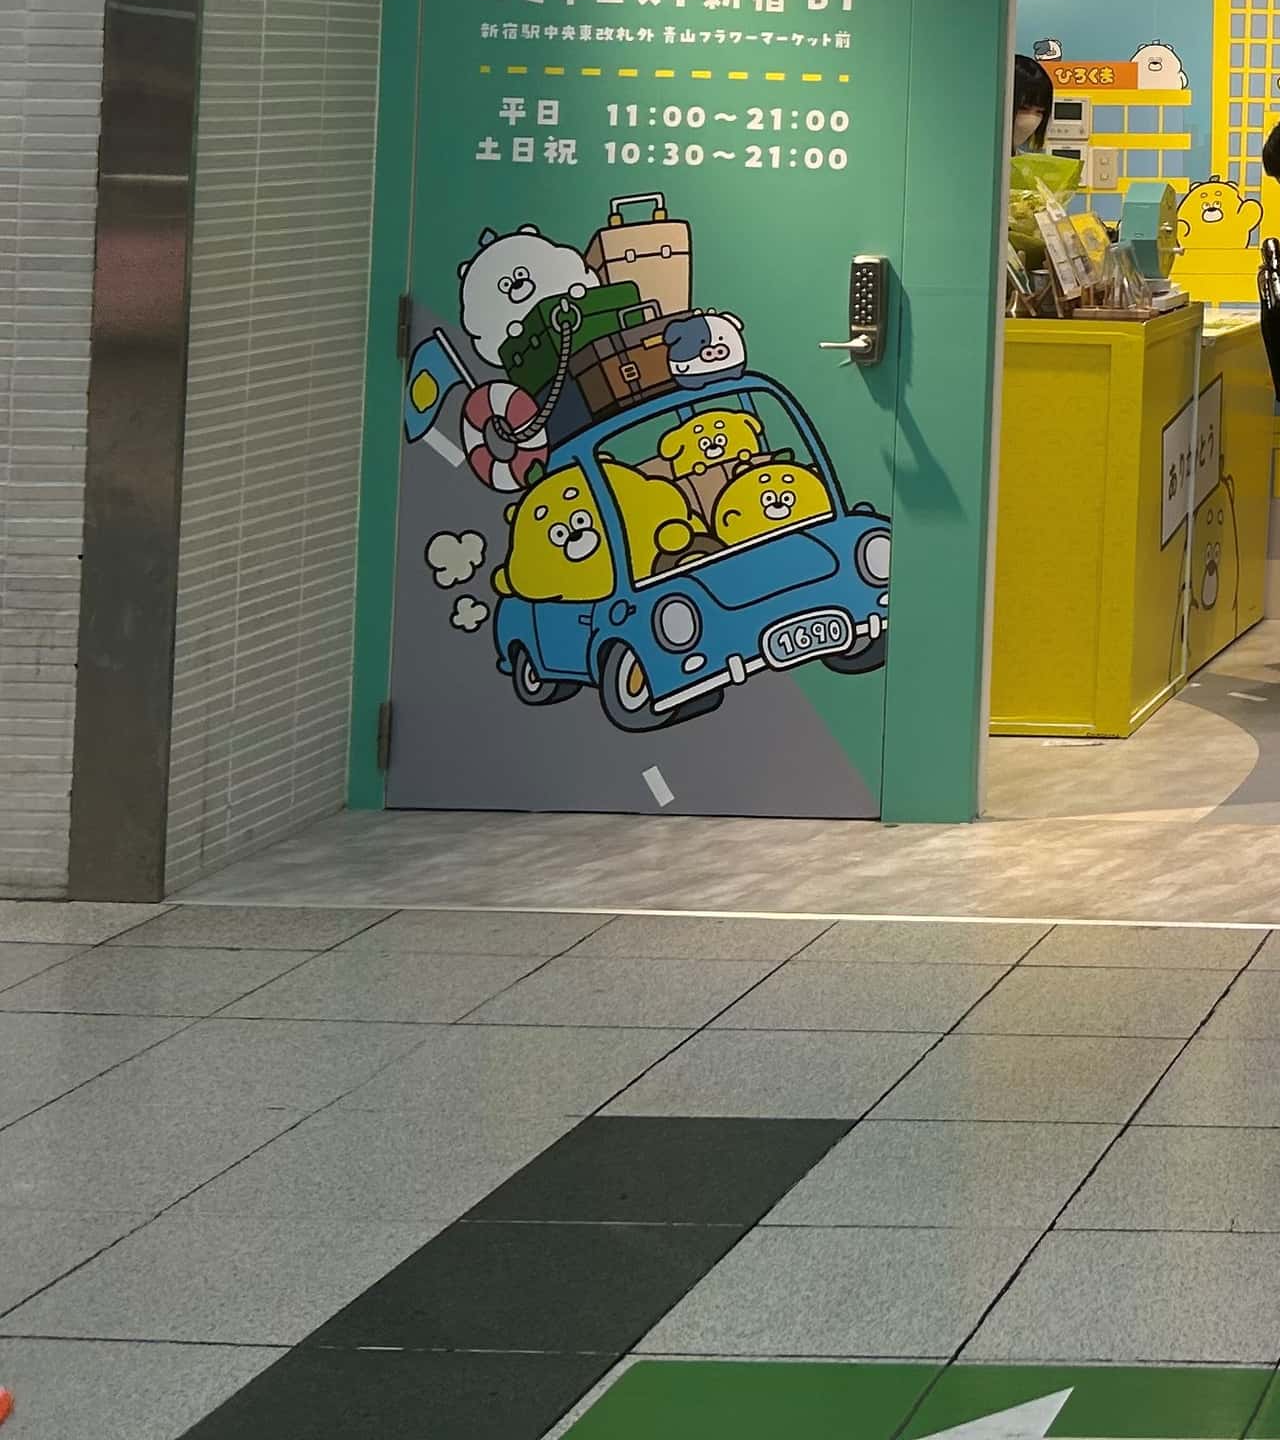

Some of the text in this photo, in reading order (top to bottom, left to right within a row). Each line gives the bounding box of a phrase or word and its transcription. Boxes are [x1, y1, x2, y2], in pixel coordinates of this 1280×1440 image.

[480, 23, 851, 49] 新宿駅中央東改札外 青山フラワーマーケット前
[1055, 67, 1114, 84] ひろくま
[500, 97, 559, 127] 平日
[476, 135, 577, 165] 土日祝
[777, 620, 841, 656] 1690
